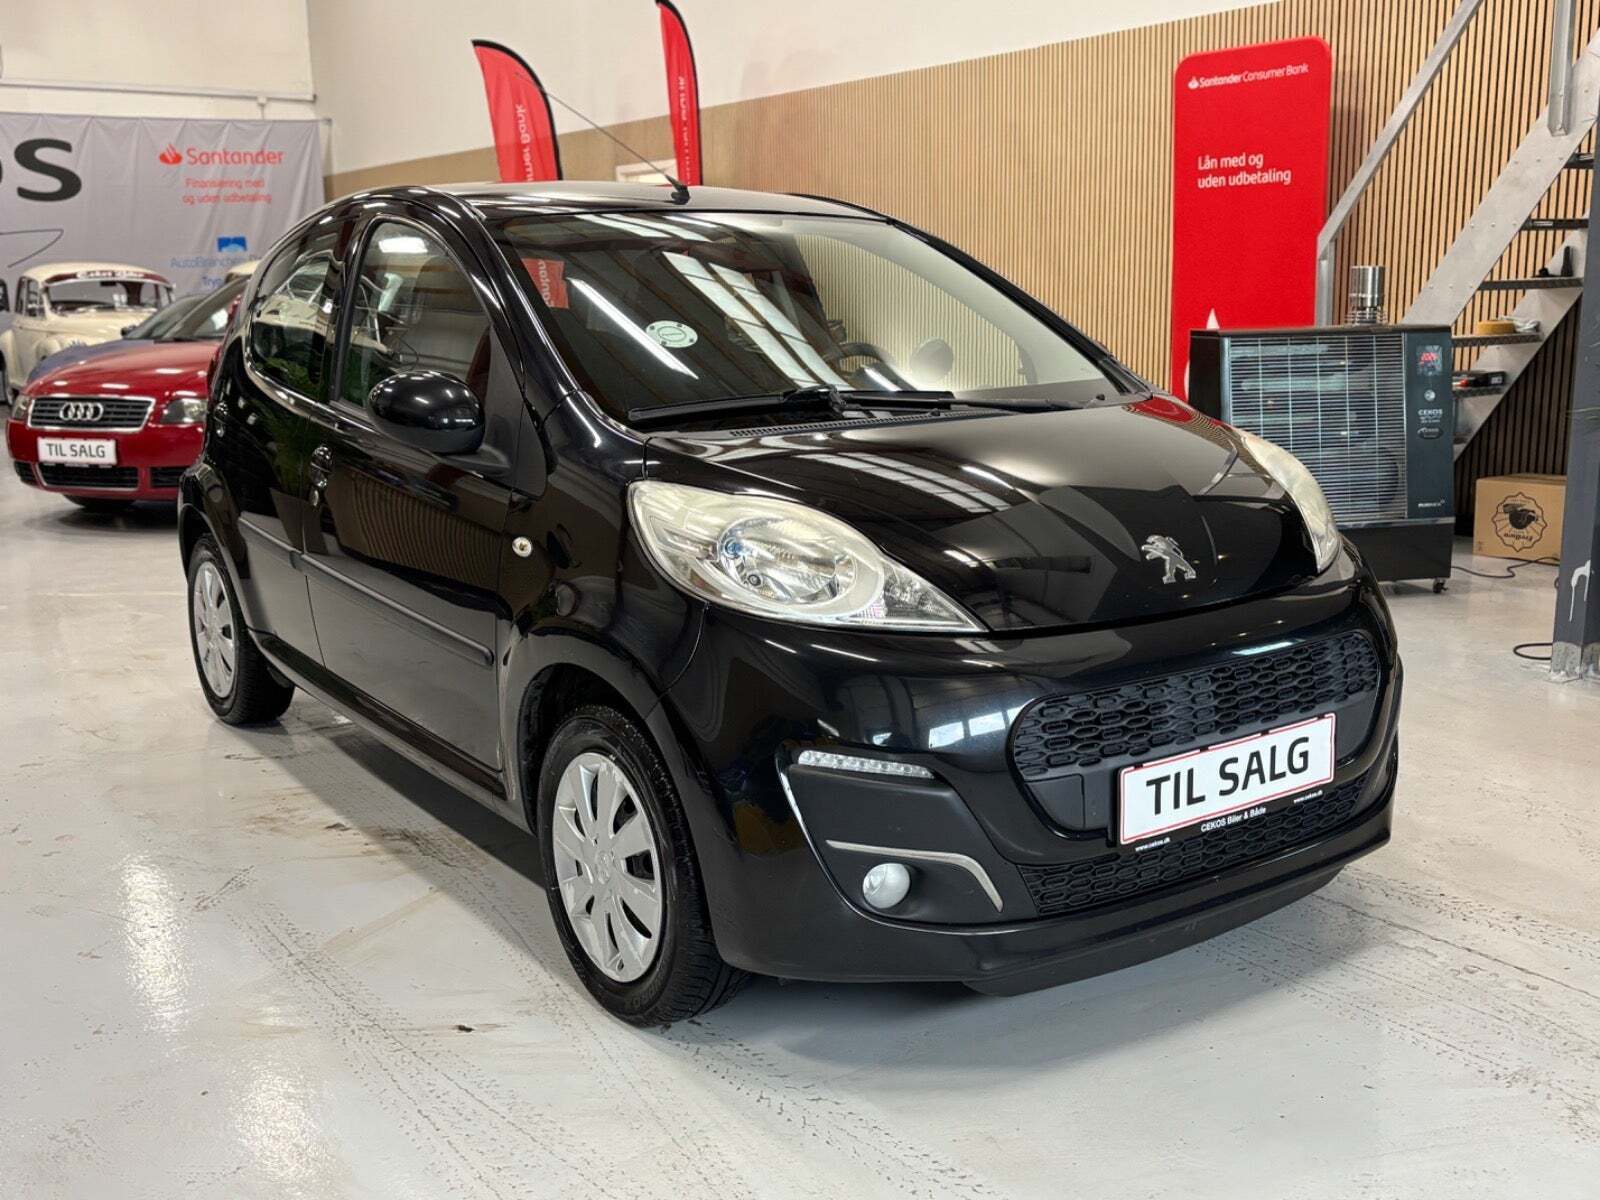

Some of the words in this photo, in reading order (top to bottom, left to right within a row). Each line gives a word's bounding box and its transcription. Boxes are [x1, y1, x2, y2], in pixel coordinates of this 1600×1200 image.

[1199, 74, 1242, 89] Santander
[1242, 66, 1286, 82] Consumer
[1286, 63, 1309, 76] Bank
[186, 147, 284, 166] Santander
[1197, 154, 1218, 171] Lån
[1220, 152, 1246, 168] med
[1248, 153, 1264, 169] og
[1197, 174, 1226, 188] uden
[1228, 168, 1291, 186] udbetaling
[46, 443, 67, 457] TIL
[70, 444, 106, 458] SALG
[1145, 767, 1206, 816] TIL
[1218, 736, 1310, 797] SALG
[1200, 817, 1227, 833] CEKOS
[1227, 814, 1243, 825] Biler
[1243, 810, 1249, 819] &
[1249, 806, 1267, 818] Både
